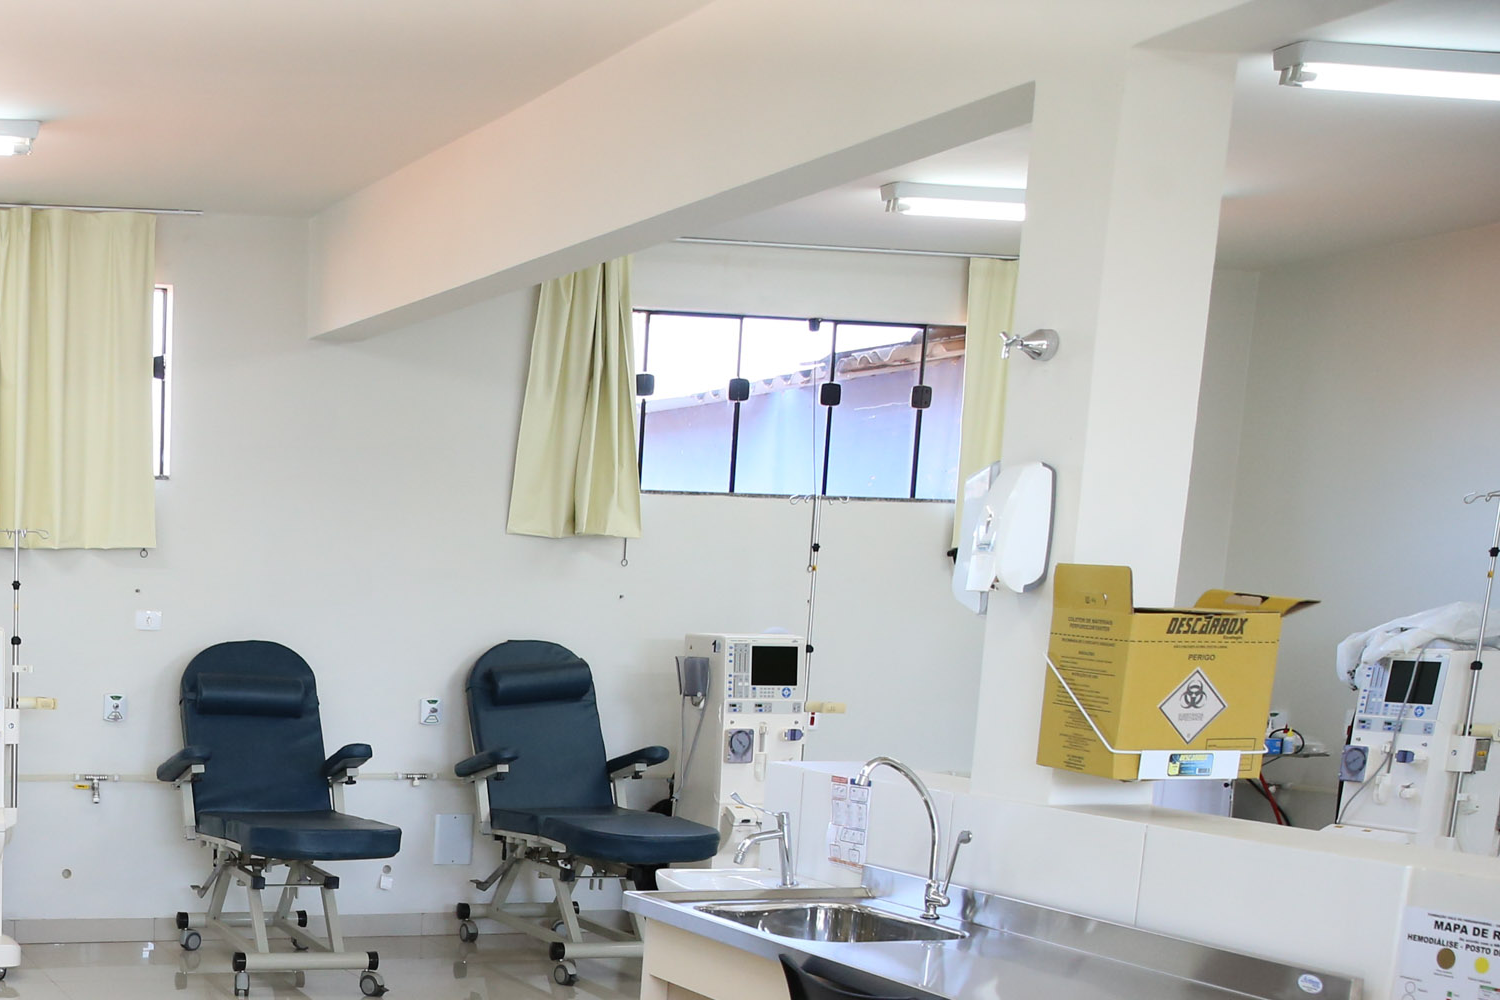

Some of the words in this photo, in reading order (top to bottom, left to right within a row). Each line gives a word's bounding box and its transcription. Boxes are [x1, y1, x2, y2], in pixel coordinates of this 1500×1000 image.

[711, 640, 716, 652] 1
[1188, 653, 1216, 661] PERIGO
[1433, 920, 1468, 935] MAPA
[1472, 926, 1489, 938] DE
[1407, 933, 1459, 949] HEMODIÁLISE
[1465, 943, 1491, 955] POSTO
